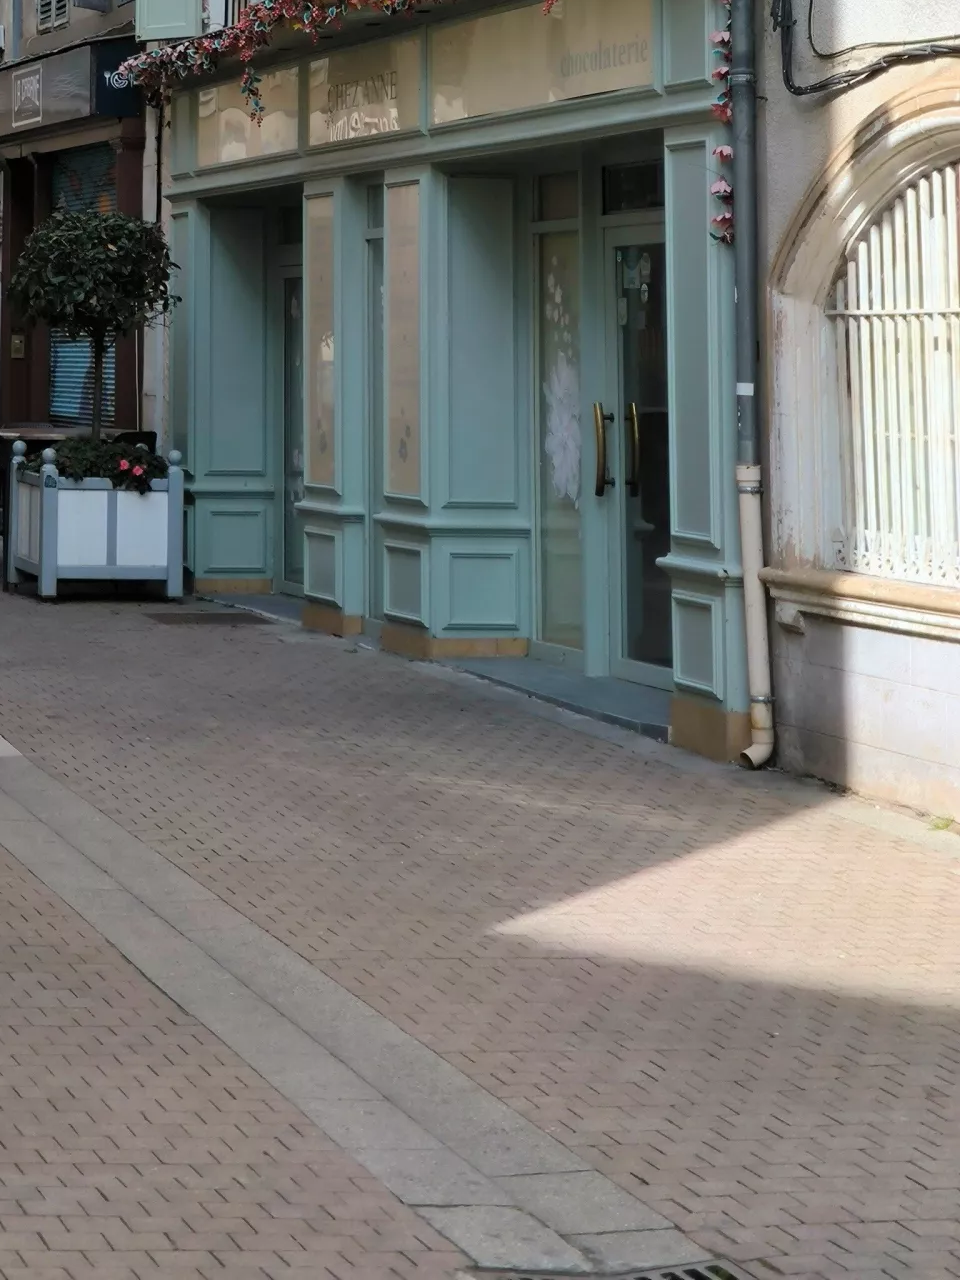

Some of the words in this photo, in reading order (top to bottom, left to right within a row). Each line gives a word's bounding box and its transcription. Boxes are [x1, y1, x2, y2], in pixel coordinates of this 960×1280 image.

[560, 34, 648, 78] chocolaterie
[327, 81, 359, 113] CHEZ
[361, 71, 398, 106] ANNE
